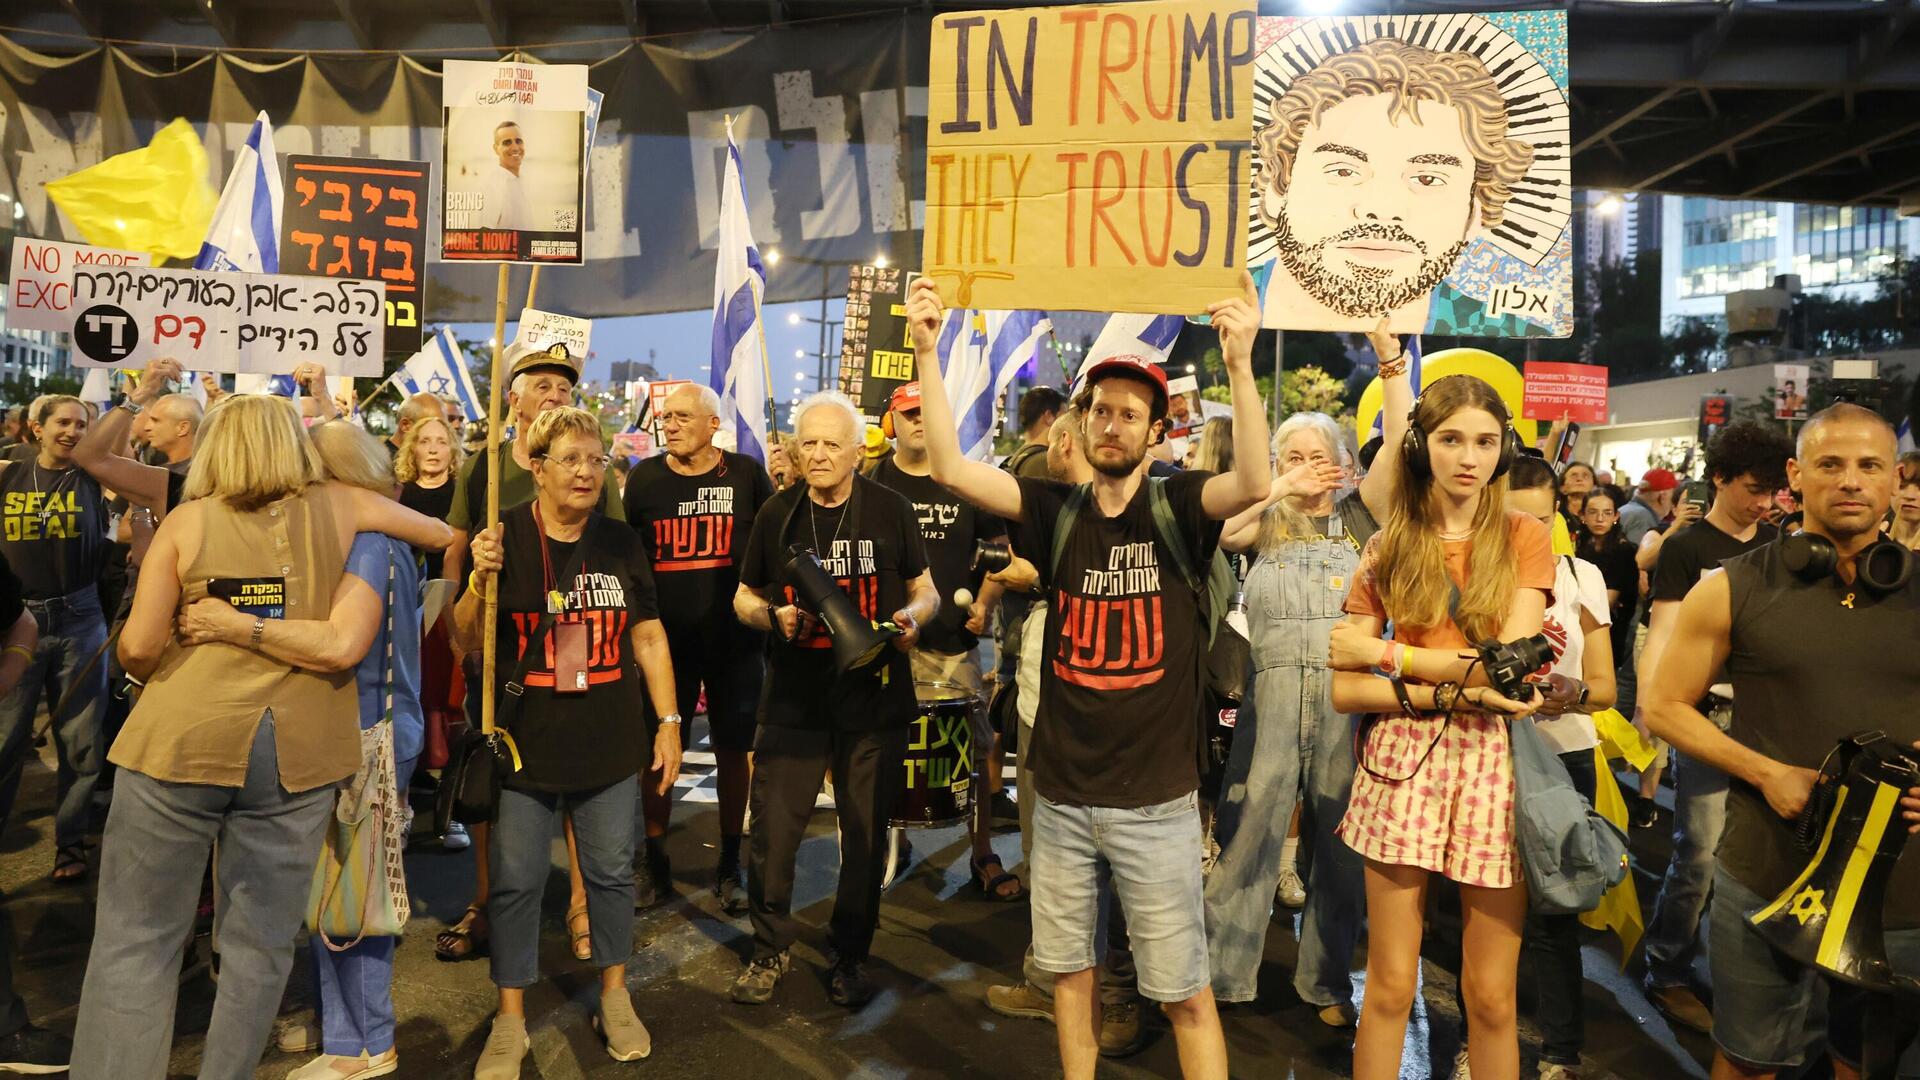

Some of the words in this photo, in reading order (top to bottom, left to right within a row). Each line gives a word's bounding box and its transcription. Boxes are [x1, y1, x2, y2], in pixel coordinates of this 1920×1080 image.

[941, 16, 1037, 134] IN
[1060, 9, 1257, 126] TRUMP
[493, 80, 512, 89] OMRI
[513, 80, 538, 92] MIRAN
[294, 176, 419, 230] ביבי
[447, 191, 484, 211] BRING
[930, 153, 1031, 266] THEY
[1055, 139, 1252, 268] TRUST
[446, 211, 470, 230] HIM
[290, 229, 415, 282] בוגד
[445, 232, 479, 250] HOME
[482, 231, 519, 252] NOW!
[23, 245, 61, 274] NO
[16, 279, 73, 311] EXC
[1491, 284, 1549, 315] אלון
[153, 313, 207, 350] דם
[238, 322, 319, 352] הידיים
[332, 322, 372, 357] על
[875, 353, 911, 378] THE
[4, 490, 84, 515] SEAL
[697, 486, 734, 500] מחזירים
[709, 500, 733, 514] אותם
[678, 501, 708, 516] הביתה
[4, 514, 82, 542] DEAL
[653, 515, 734, 560] עכשיו
[242, 583, 283, 595] הפקרת
[1082, 568, 1125, 597] הביתה
[1126, 566, 1161, 594] אותם
[230, 594, 283, 606] החטופים
[593, 589, 627, 608] אותם
[269, 608, 283, 618] או
